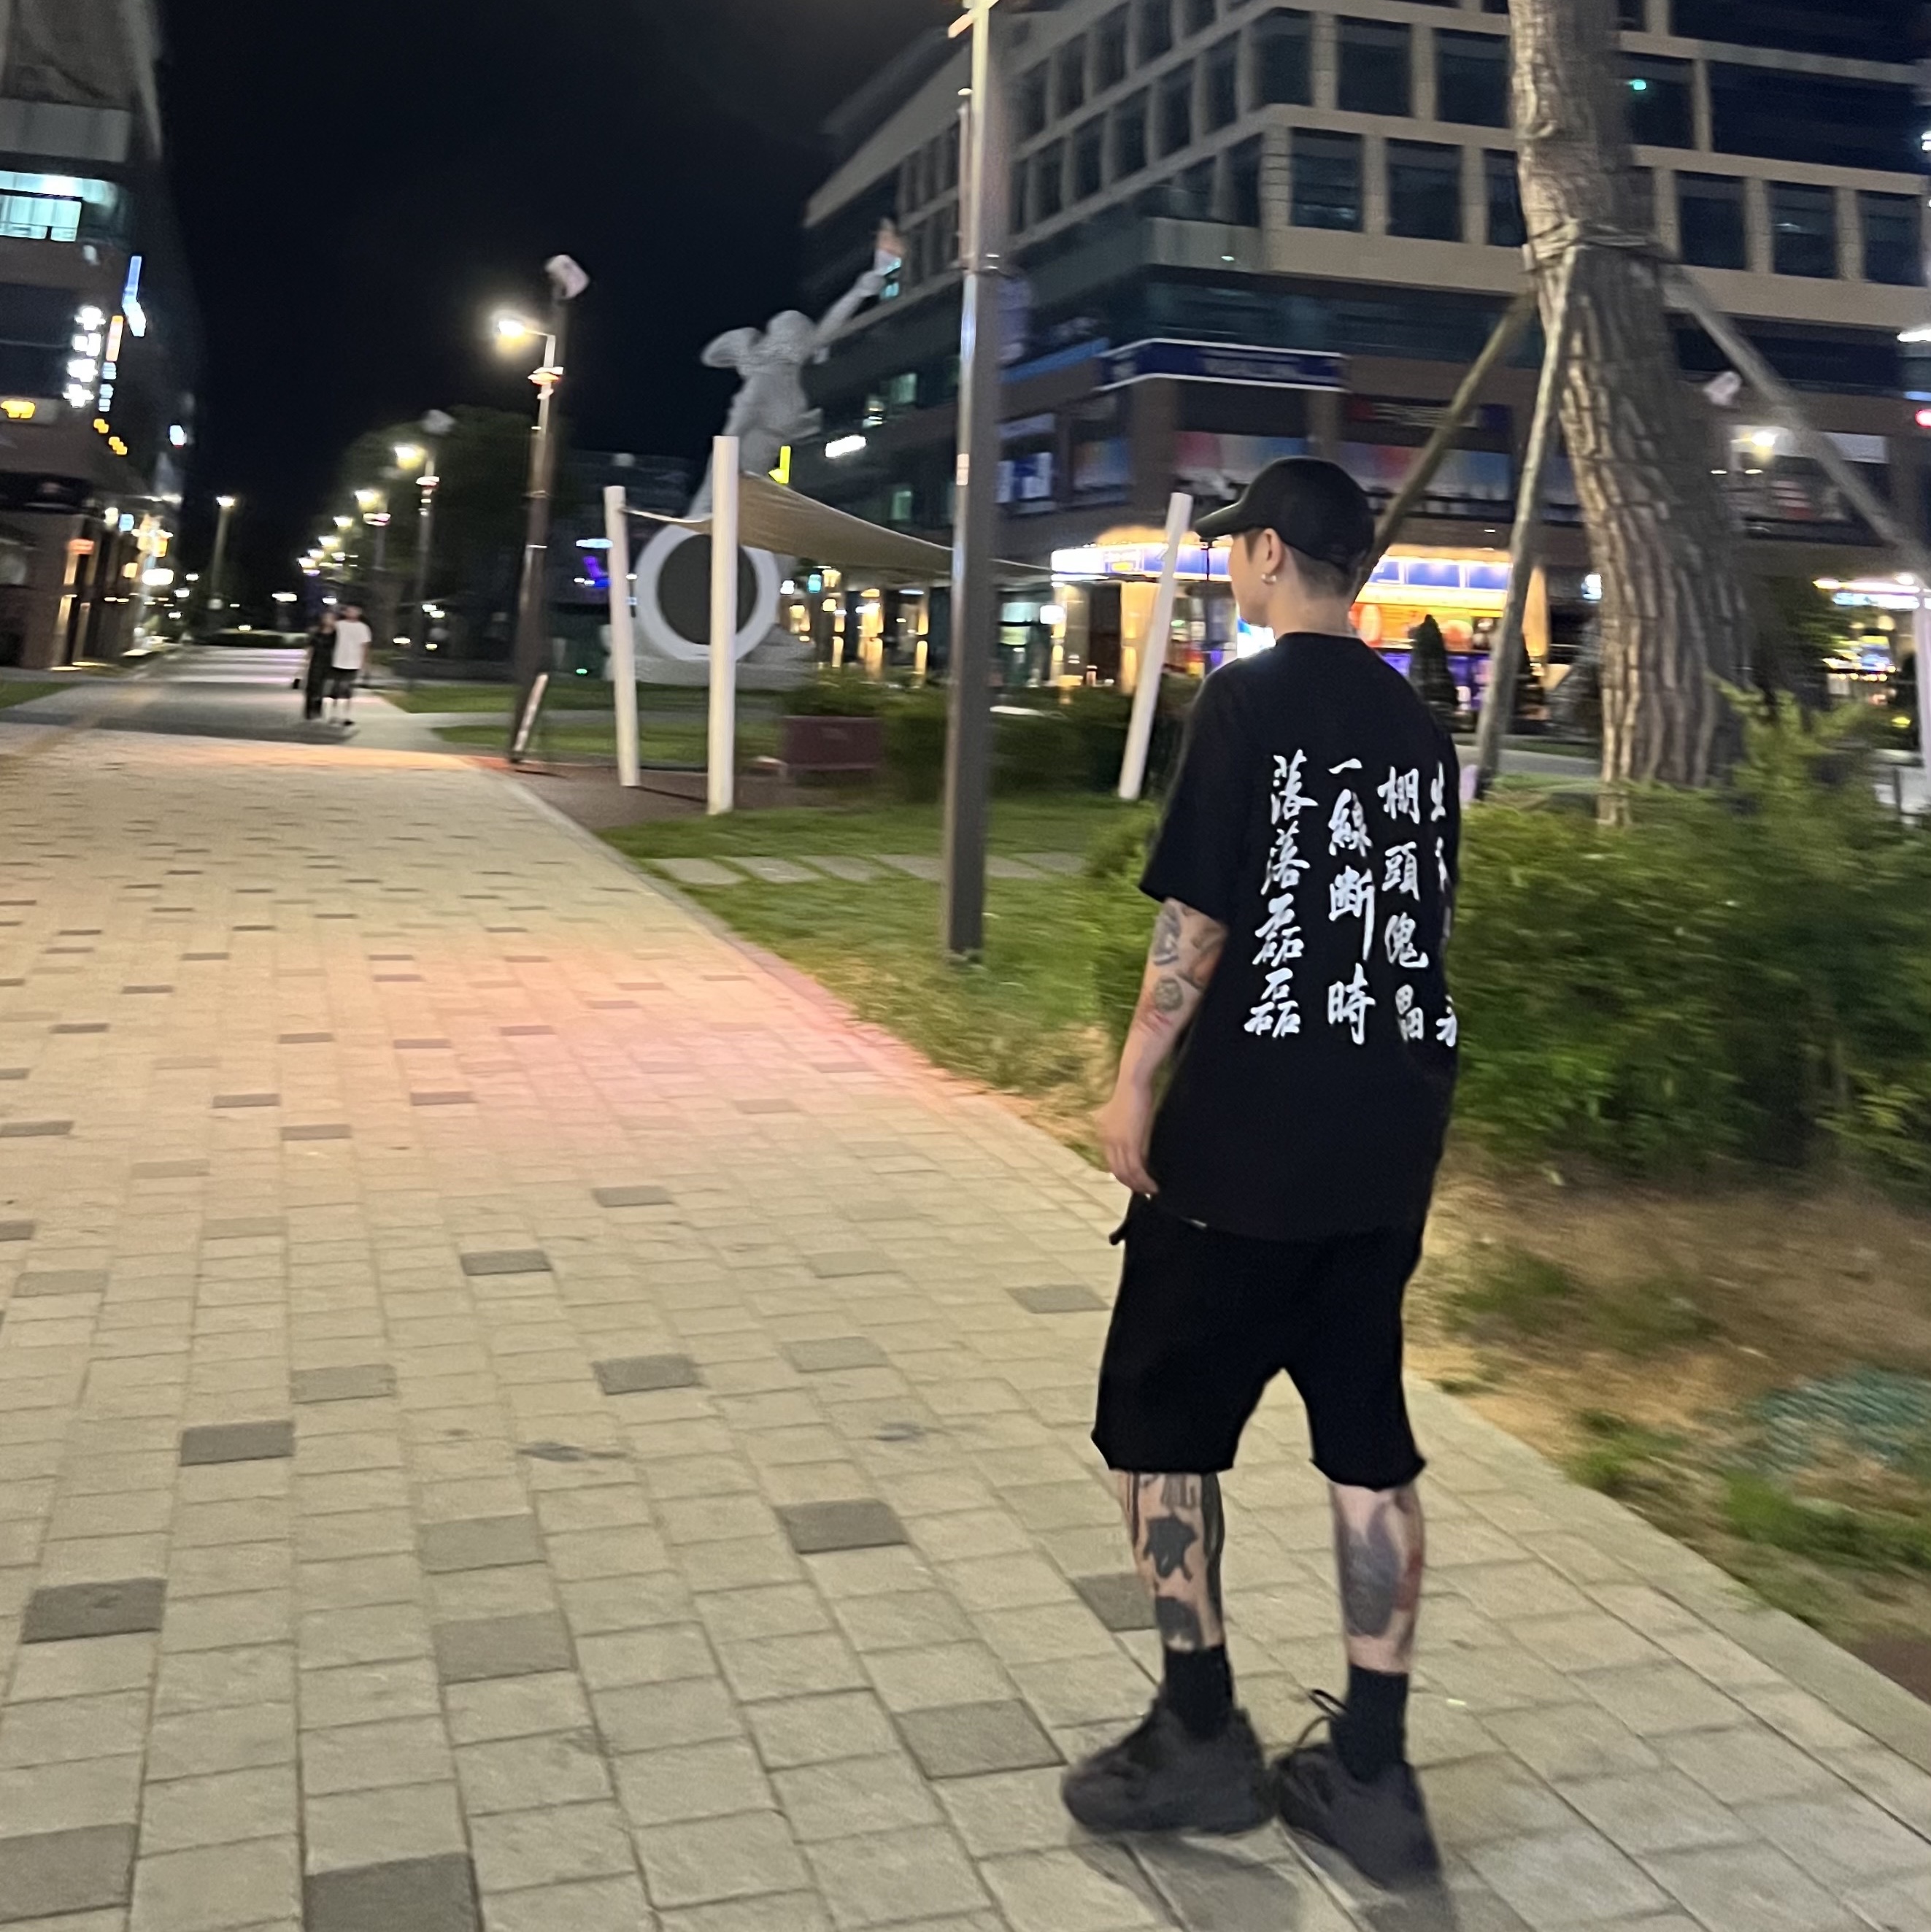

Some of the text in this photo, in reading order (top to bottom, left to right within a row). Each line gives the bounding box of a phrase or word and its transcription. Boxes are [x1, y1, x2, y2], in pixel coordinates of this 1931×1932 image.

[1244, 749, 1319, 1039] 落落磊磊
[1327, 758, 1376, 1045] 一線斷時
